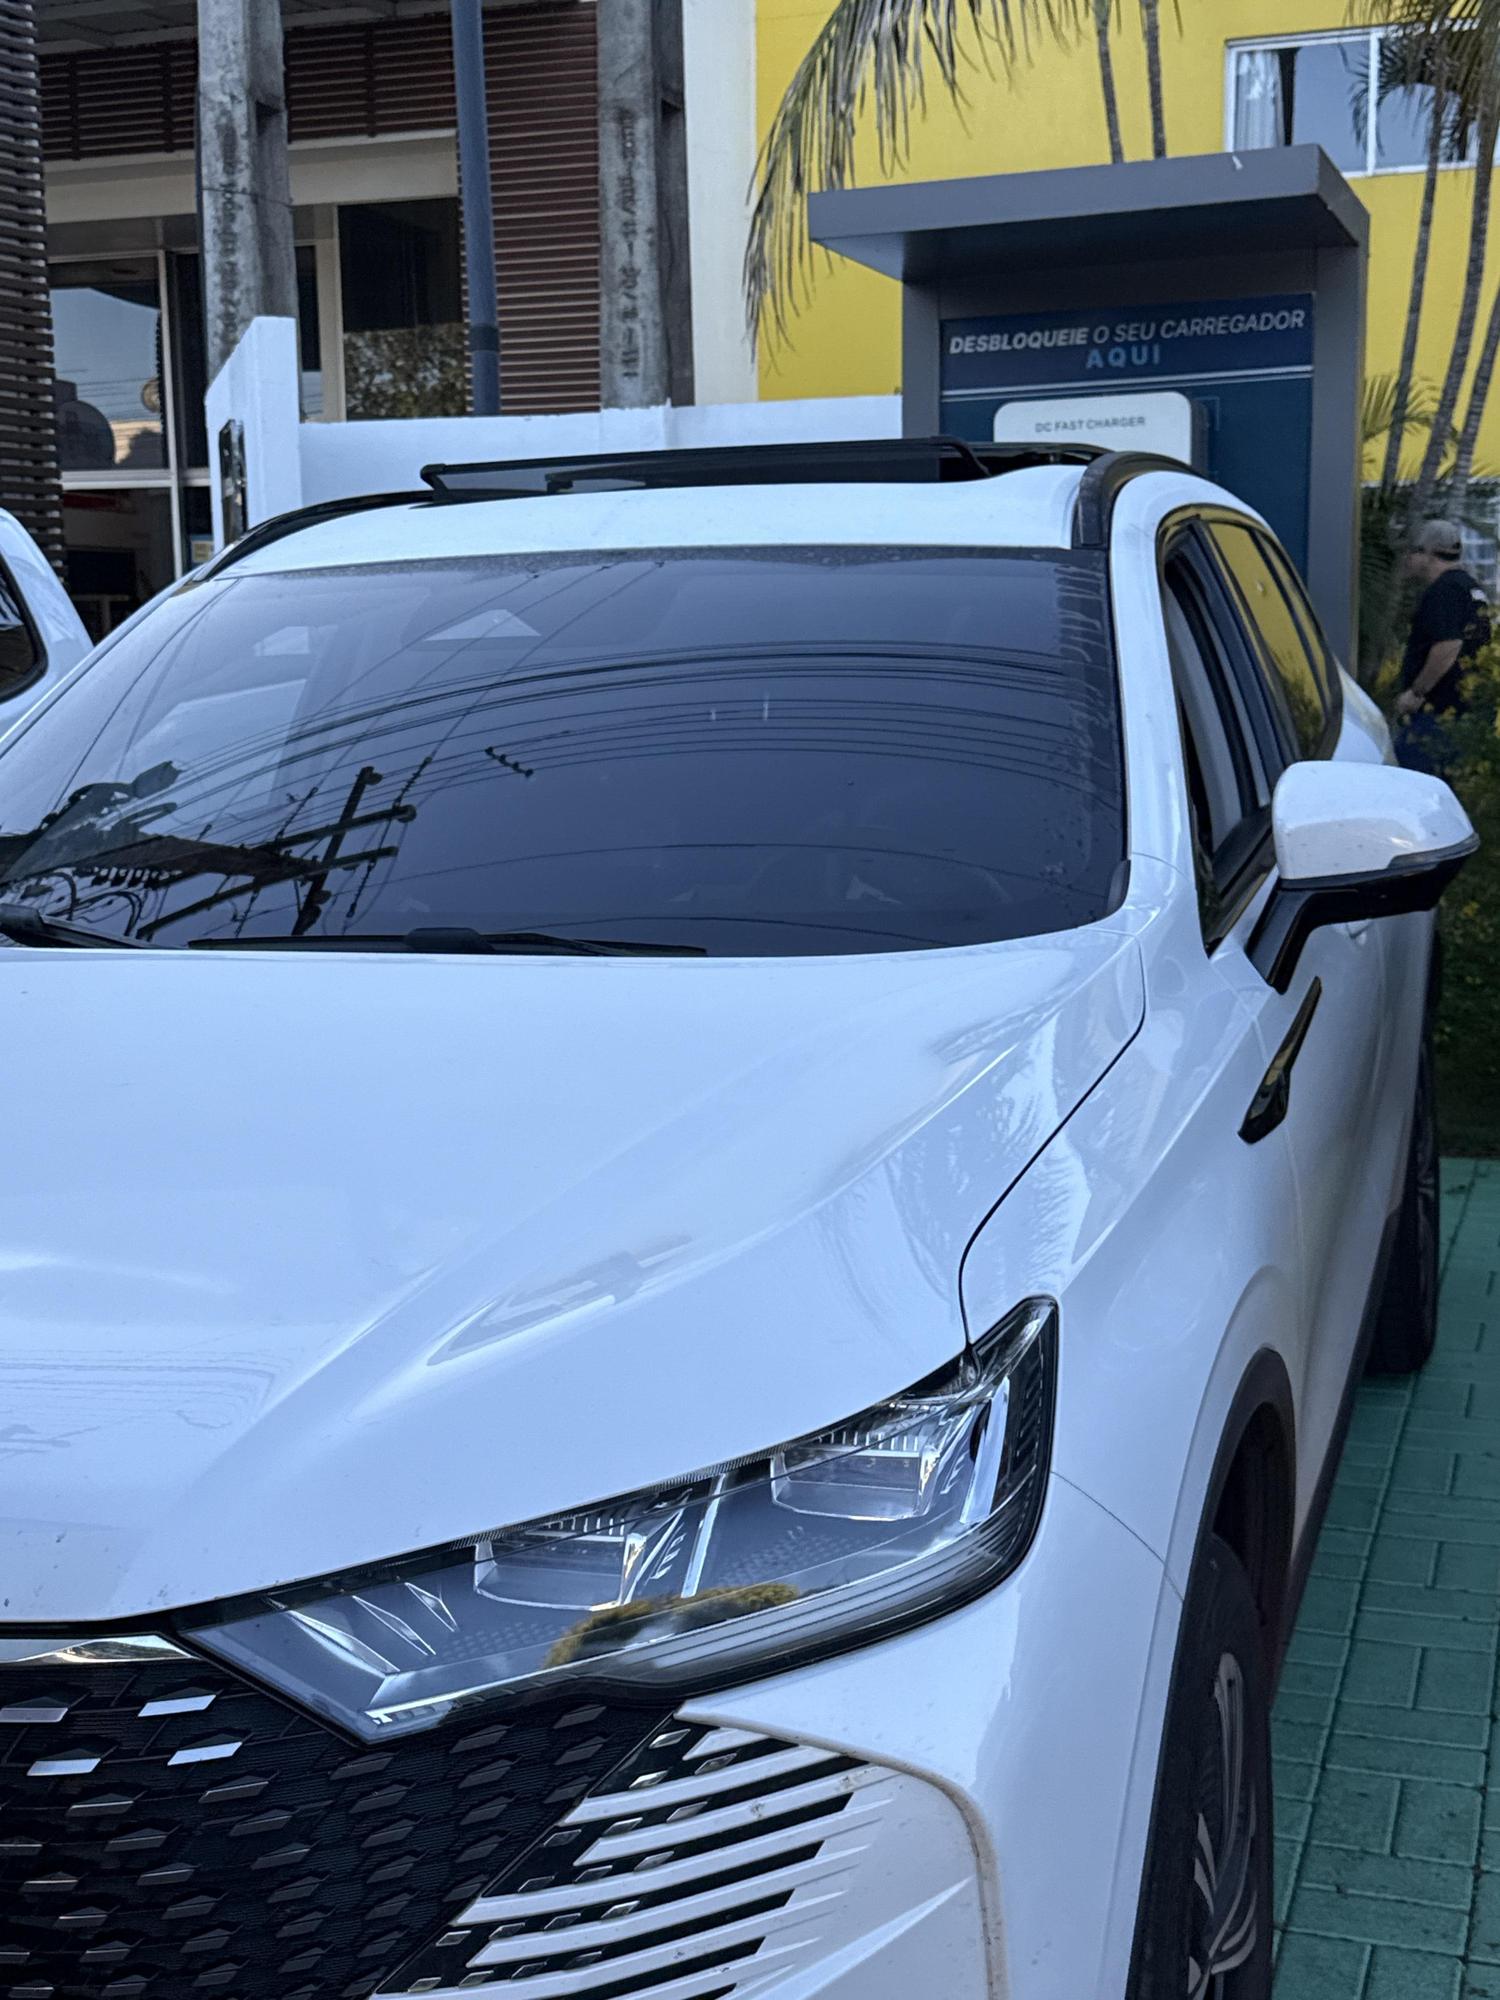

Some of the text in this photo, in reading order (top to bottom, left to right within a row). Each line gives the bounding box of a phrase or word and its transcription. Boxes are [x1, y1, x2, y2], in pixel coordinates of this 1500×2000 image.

[949, 309, 1305, 354] DESBLOQUEIE O SEU CARREGADOR
[1086, 344, 1160, 369] AQUI
[1035, 416, 1145, 433] DC FAST CHARGER
